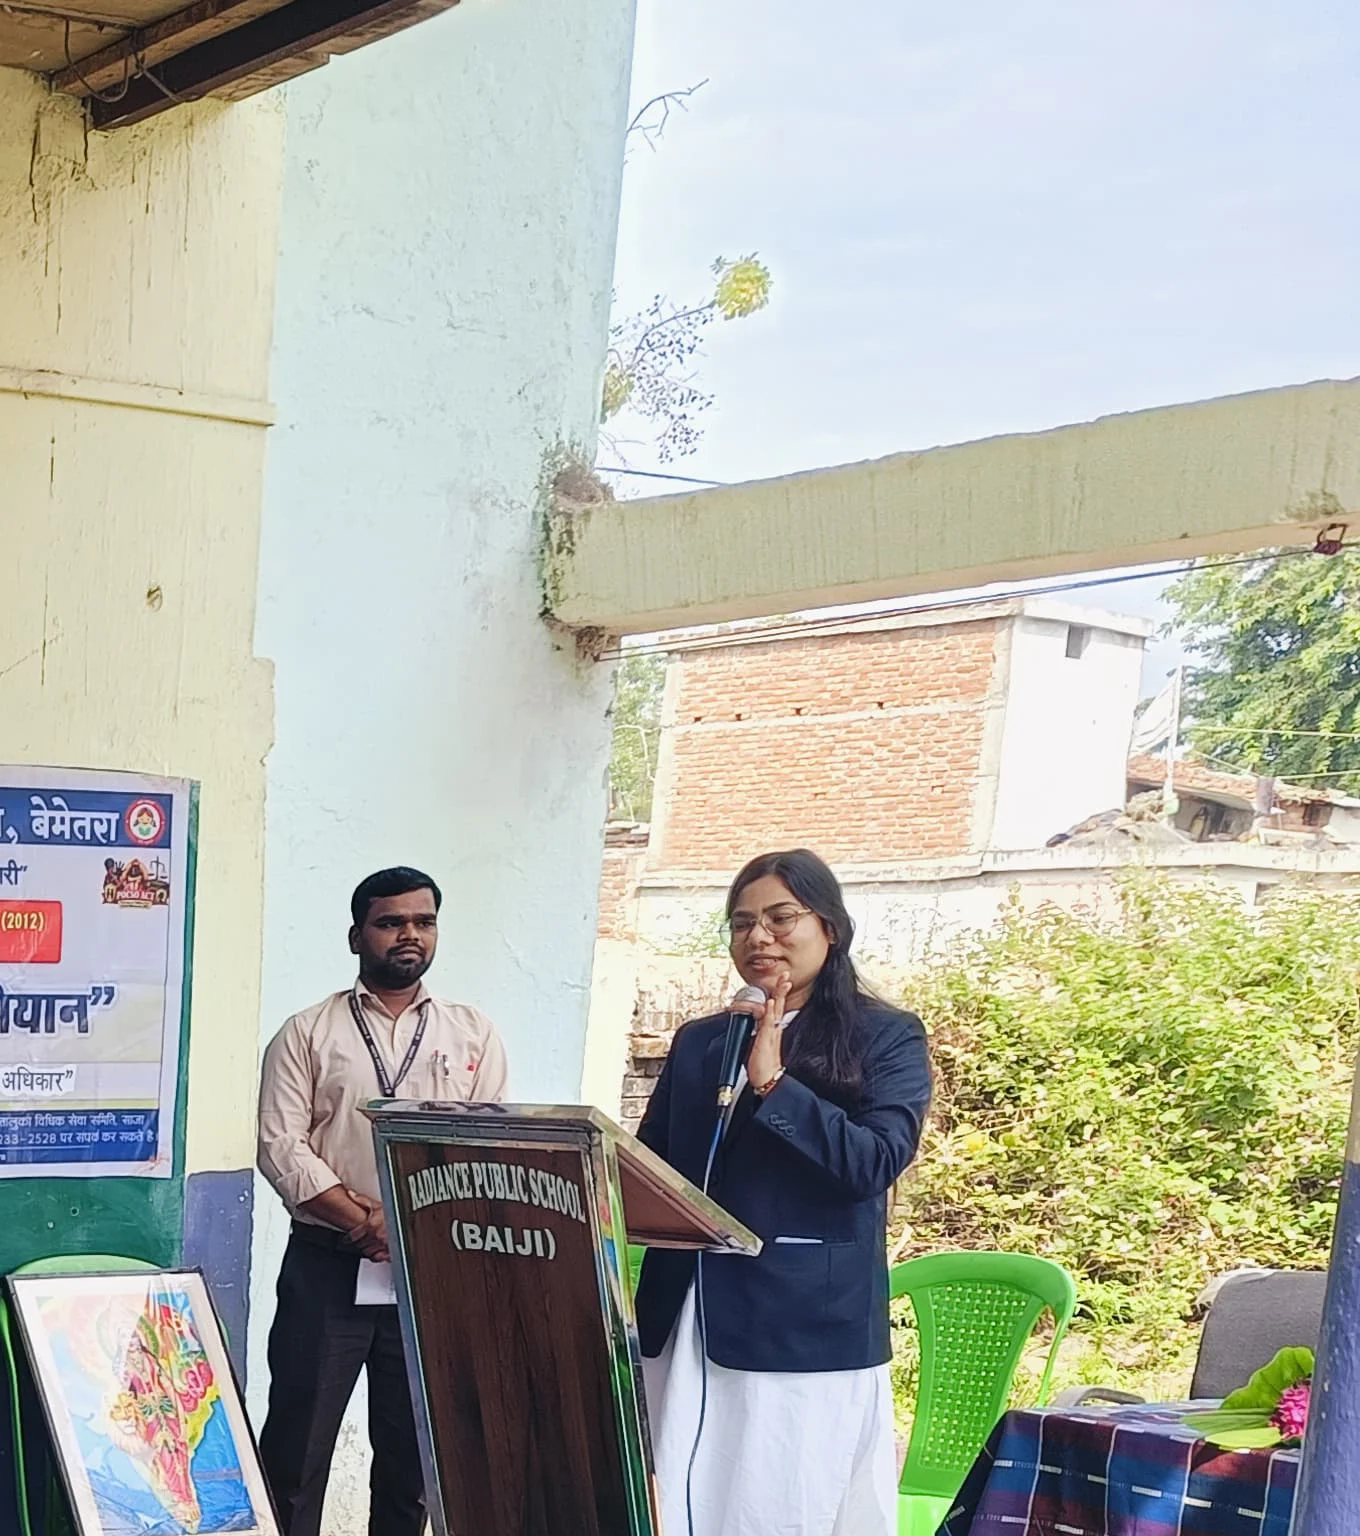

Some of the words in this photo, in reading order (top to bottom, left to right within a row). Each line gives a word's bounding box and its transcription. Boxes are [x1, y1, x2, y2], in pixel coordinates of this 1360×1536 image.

[31, 794, 119, 844] बेमेतरा
[1, 910, 45, 931] (2012)
[34, 1113, 66, 1128] विधिक
[408, 1162, 473, 1211] RADIANCE
[471, 1162, 529, 1204] PUBLIC
[530, 1168, 586, 1224] SCHOOL
[451, 1219, 556, 1260] (BAIJI)
